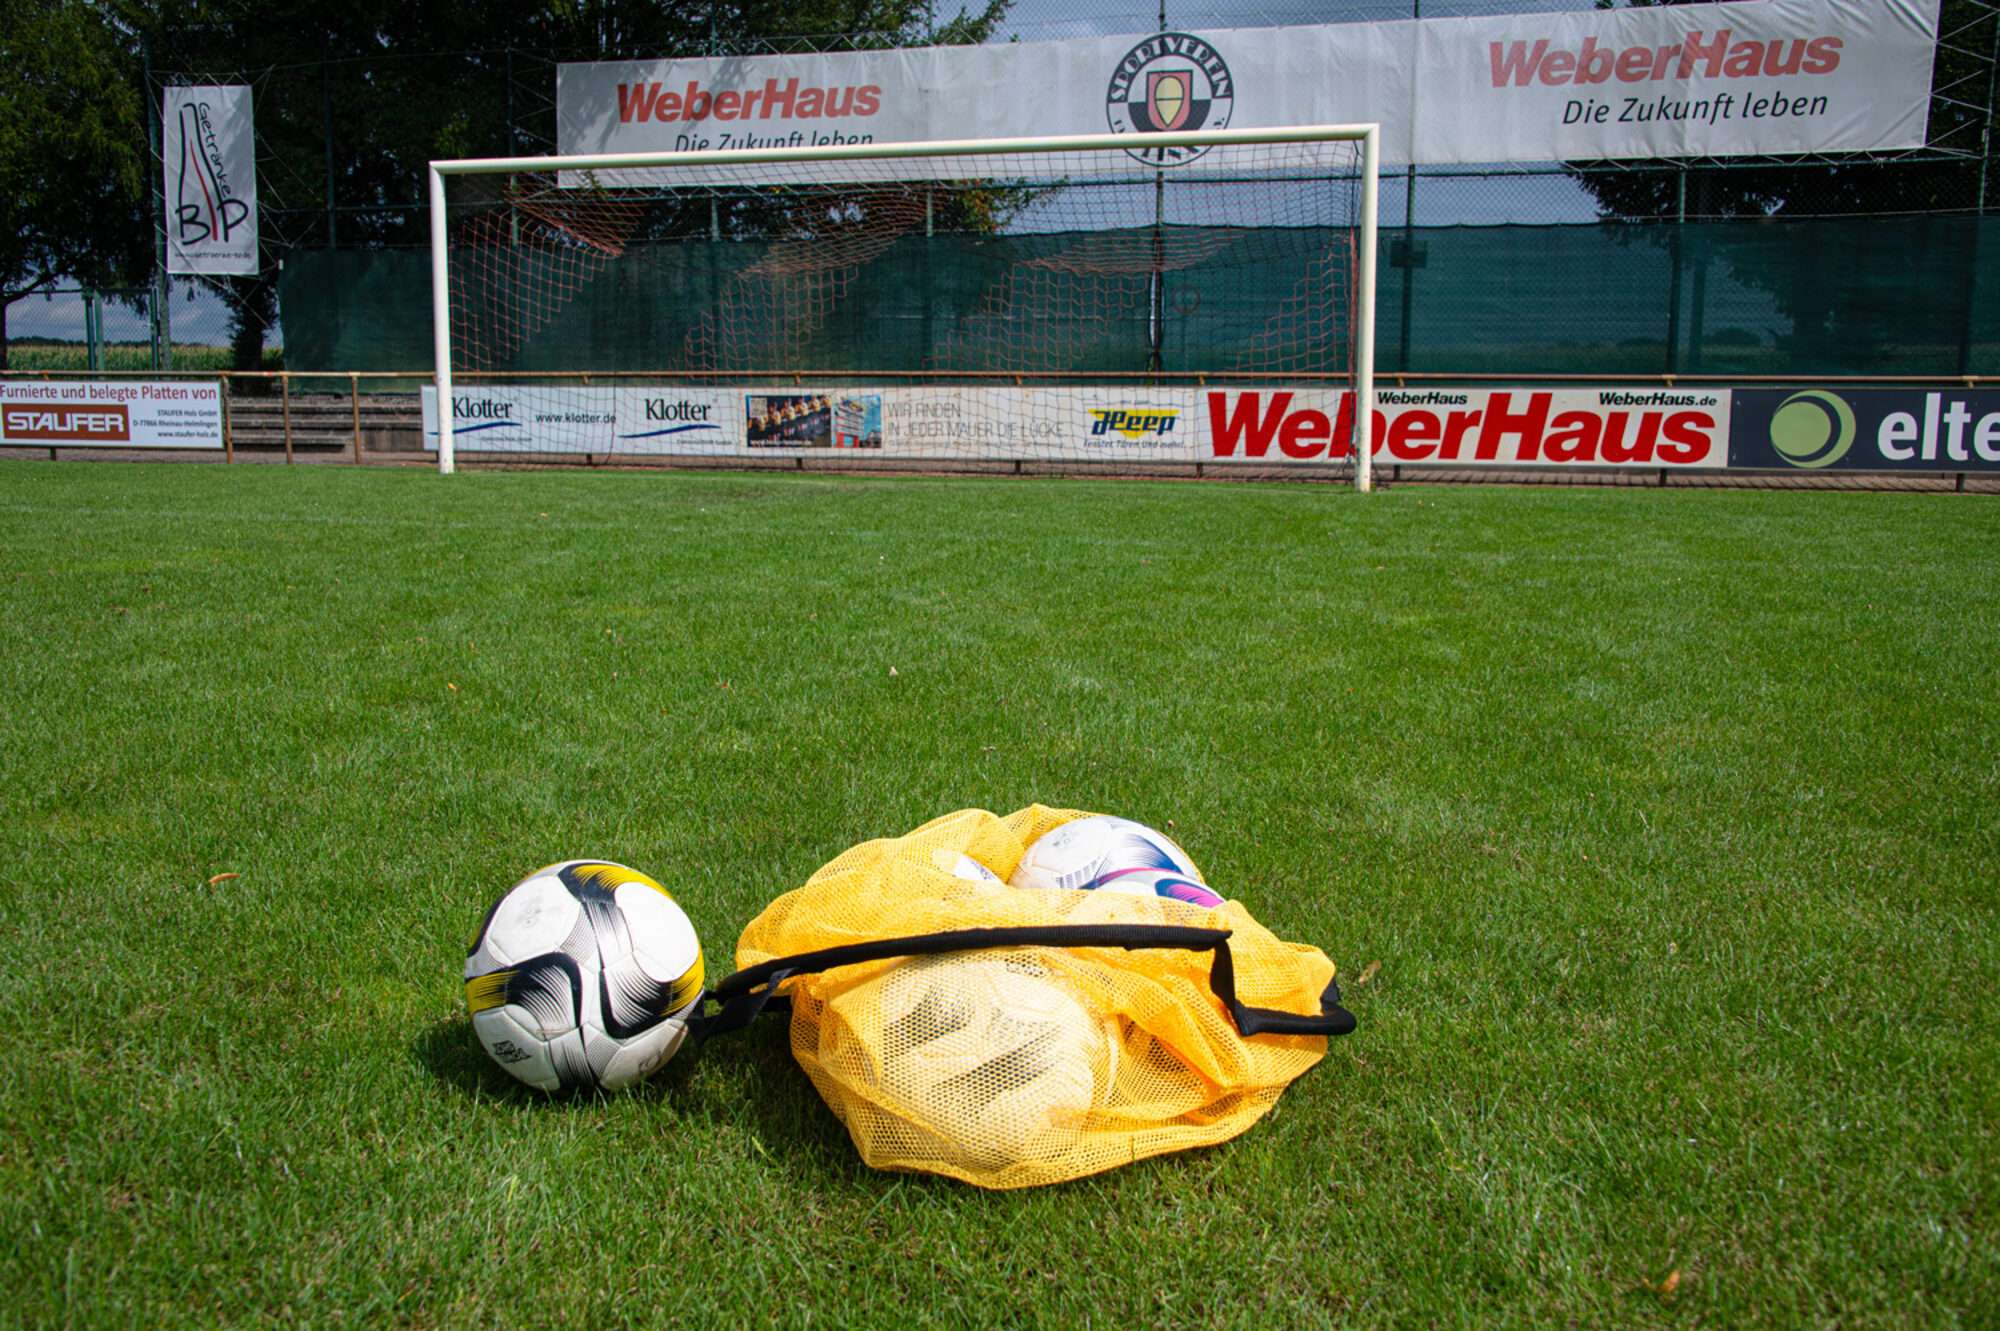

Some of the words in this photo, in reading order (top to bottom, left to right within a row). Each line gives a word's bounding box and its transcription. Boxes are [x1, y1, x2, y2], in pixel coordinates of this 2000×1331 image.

[1110, 34, 1231, 101] SPORTVEREIN
[1489, 29, 1844, 88] WeberHaus
[617, 78, 882, 123] WeberHaus
[1563, 100, 1609, 125] Die
[1618, 93, 1735, 125] Zukunft
[1741, 91, 1828, 119] leben
[197, 102, 232, 198] Getränke
[675, 135, 710, 152] Die
[718, 131, 804, 151] Zukunft
[811, 130, 873, 147] leben
[0, 384, 57, 399] Furnierte
[62, 385, 86, 400] und
[89, 385, 138, 402] belegte
[141, 385, 189, 400] Platten
[193, 388, 217, 400] von
[1378, 392, 1469, 405] WeberHaus
[1599, 392, 1718, 406] WeberHaus.de
[157, 409, 183, 417] STAUFER
[452, 397, 513, 418] Klotter
[645, 398, 712, 421] Klotter
[8, 412, 125, 432] STAUFER
[535, 413, 617, 425] www.klotter.de
[1206, 390, 1716, 463] WeberHaus
